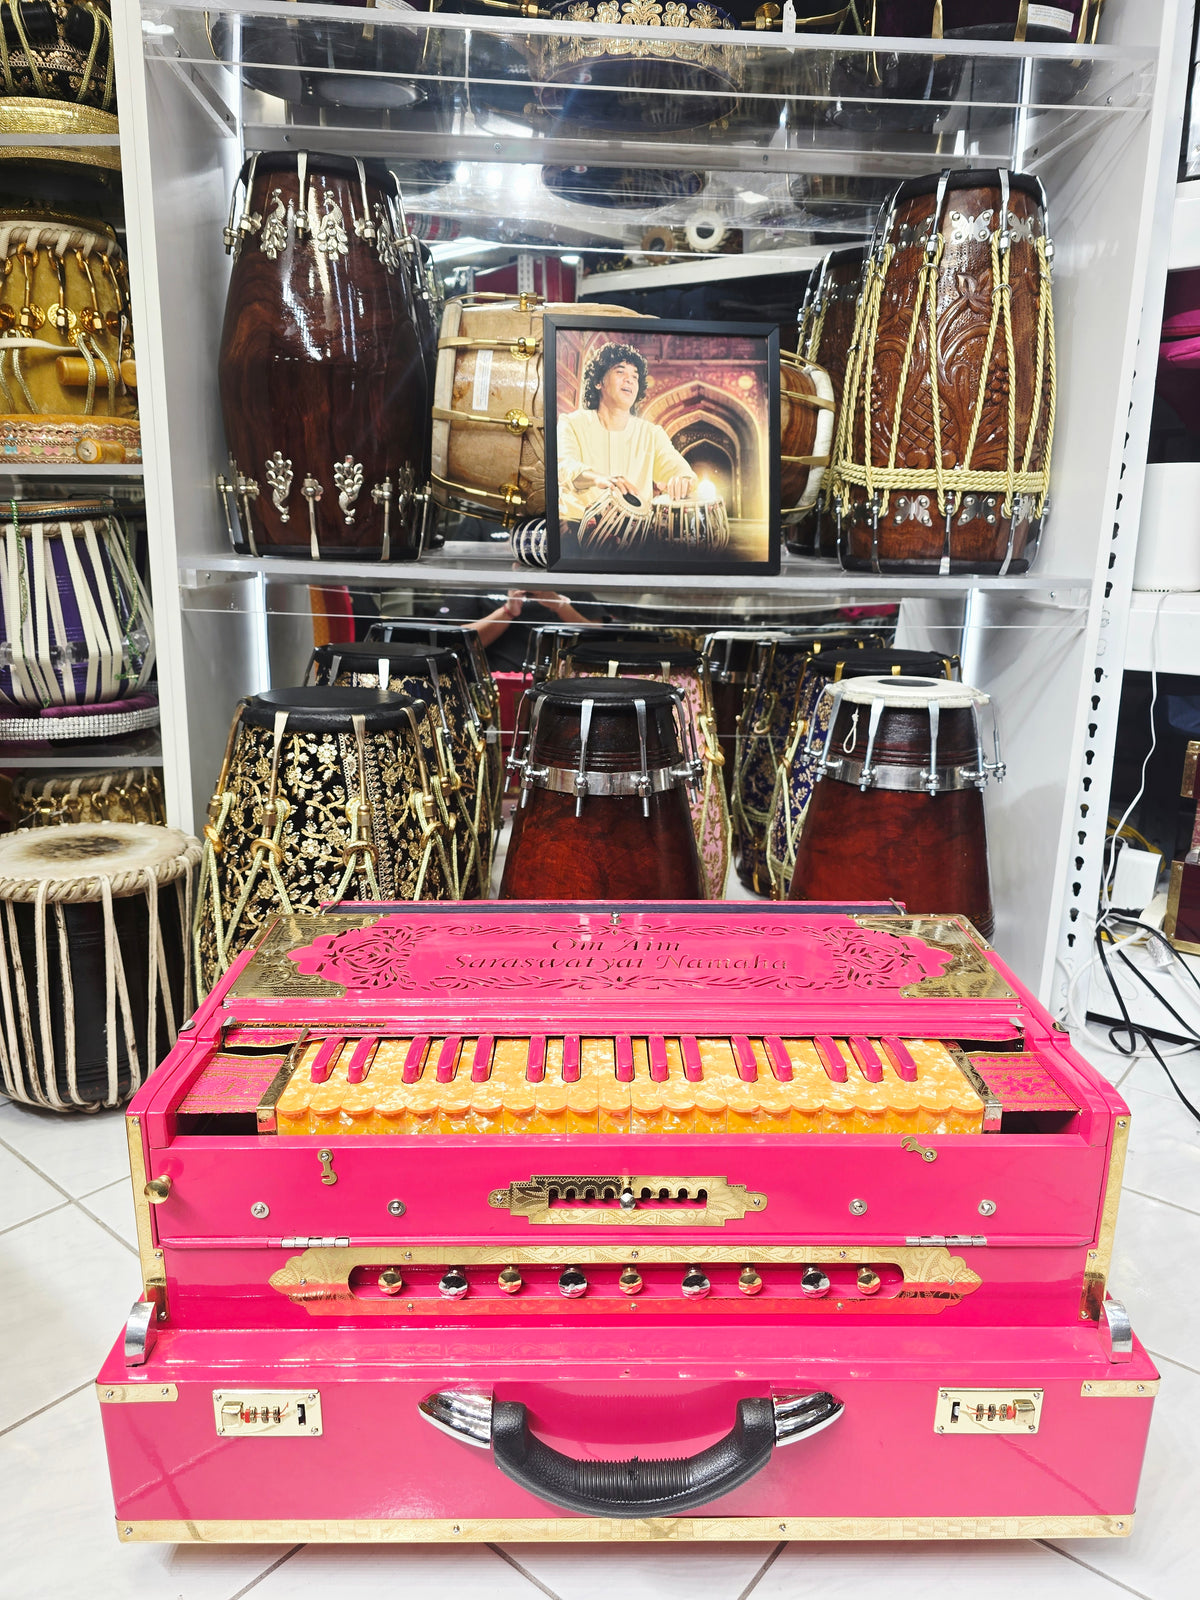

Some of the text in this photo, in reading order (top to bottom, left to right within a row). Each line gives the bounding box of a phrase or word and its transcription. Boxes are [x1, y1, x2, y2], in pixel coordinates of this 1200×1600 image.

[551, 937, 680, 952] Om Aim
[655, 953, 788, 970] Namaha
